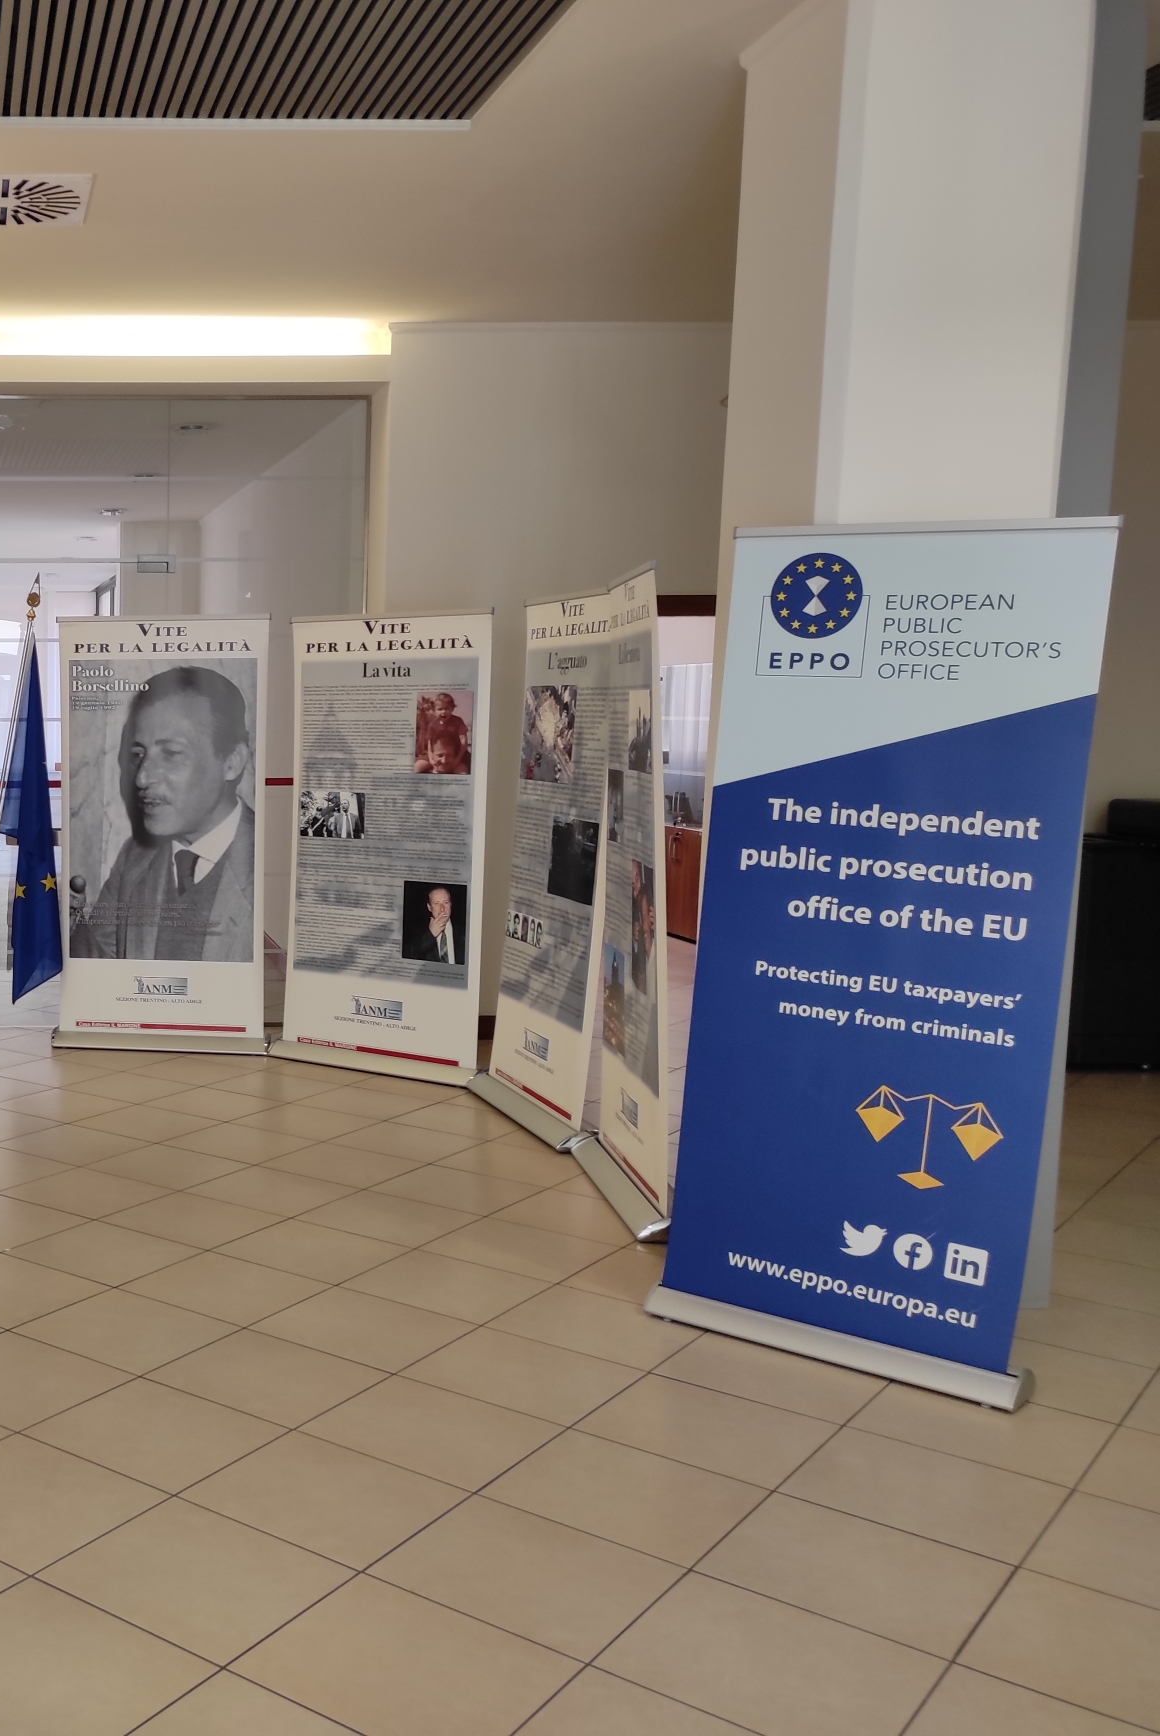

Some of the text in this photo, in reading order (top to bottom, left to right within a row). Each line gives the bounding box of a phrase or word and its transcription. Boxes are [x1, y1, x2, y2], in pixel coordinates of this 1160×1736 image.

[885, 594, 1015, 611] EUROPEAN
[531, 619, 611, 639] PER LA LEGALIT
[883, 617, 962, 634] PUBLIC
[74, 639, 252, 653] PER LA LEGALITÀ
[306, 635, 474, 653] PER LA LEGALITÀ
[880, 640, 1062, 659] PROSECUTOR'S
[362, 662, 411, 678] La vita
[768, 652, 850, 671] EPPO
[71, 665, 114, 677] Paolo
[878, 663, 960, 681] OFFICE
[72, 680, 150, 692] Borsellino
[768, 798, 1041, 840] The independent
[740, 845, 1033, 891] public prosecution
[788, 895, 1028, 941] office of the EU
[755, 960, 863, 993] Protecting
[868, 975, 898, 994] EU
[144, 984, 172, 993] ANM
[361, 1005, 388, 1017] ANM
[356, 1018, 382, 1027] TRENTINO
[778, 1000, 1015, 1048] money from criminals
[728, 1251, 977, 1329] www.eppo.europa.eu
